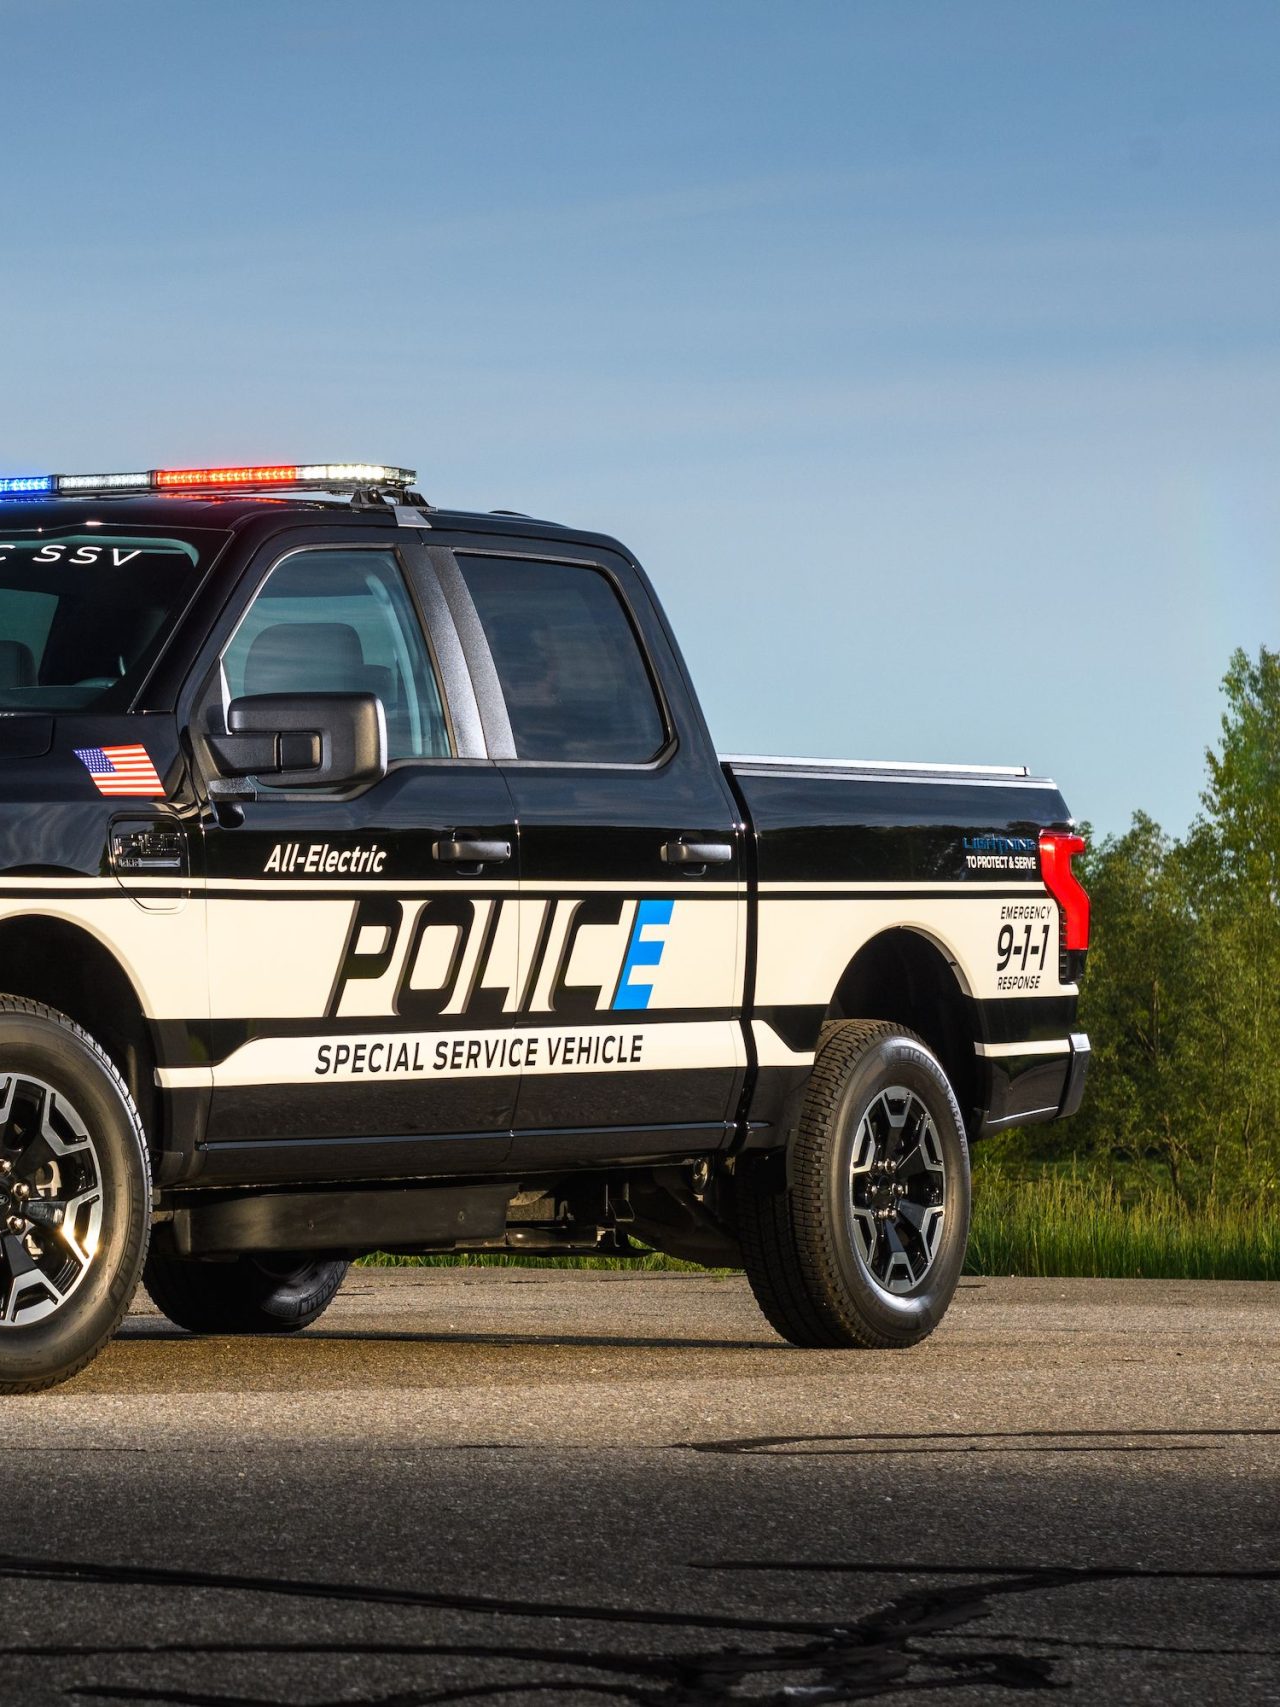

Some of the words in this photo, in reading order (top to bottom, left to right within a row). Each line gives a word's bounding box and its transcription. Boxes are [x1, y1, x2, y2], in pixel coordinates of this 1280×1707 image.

[32, 544, 143, 568] SSV
[263, 844, 387, 873] All-Electric
[966, 855, 977, 869] TO
[977, 855, 1008, 869] PROTECT
[1008, 856, 1014, 869] &
[1014, 856, 1037, 870] SERVE
[1000, 905, 1052, 920] EMERGENCY
[322, 899, 675, 1018] POLICE
[996, 923, 1050, 972] 9-1-1
[997, 975, 1041, 990] RESPONSE
[314, 1042, 425, 1075] SPECIAL
[432, 1037, 539, 1070] SERVICE
[547, 1034, 644, 1065] VEHICLE
